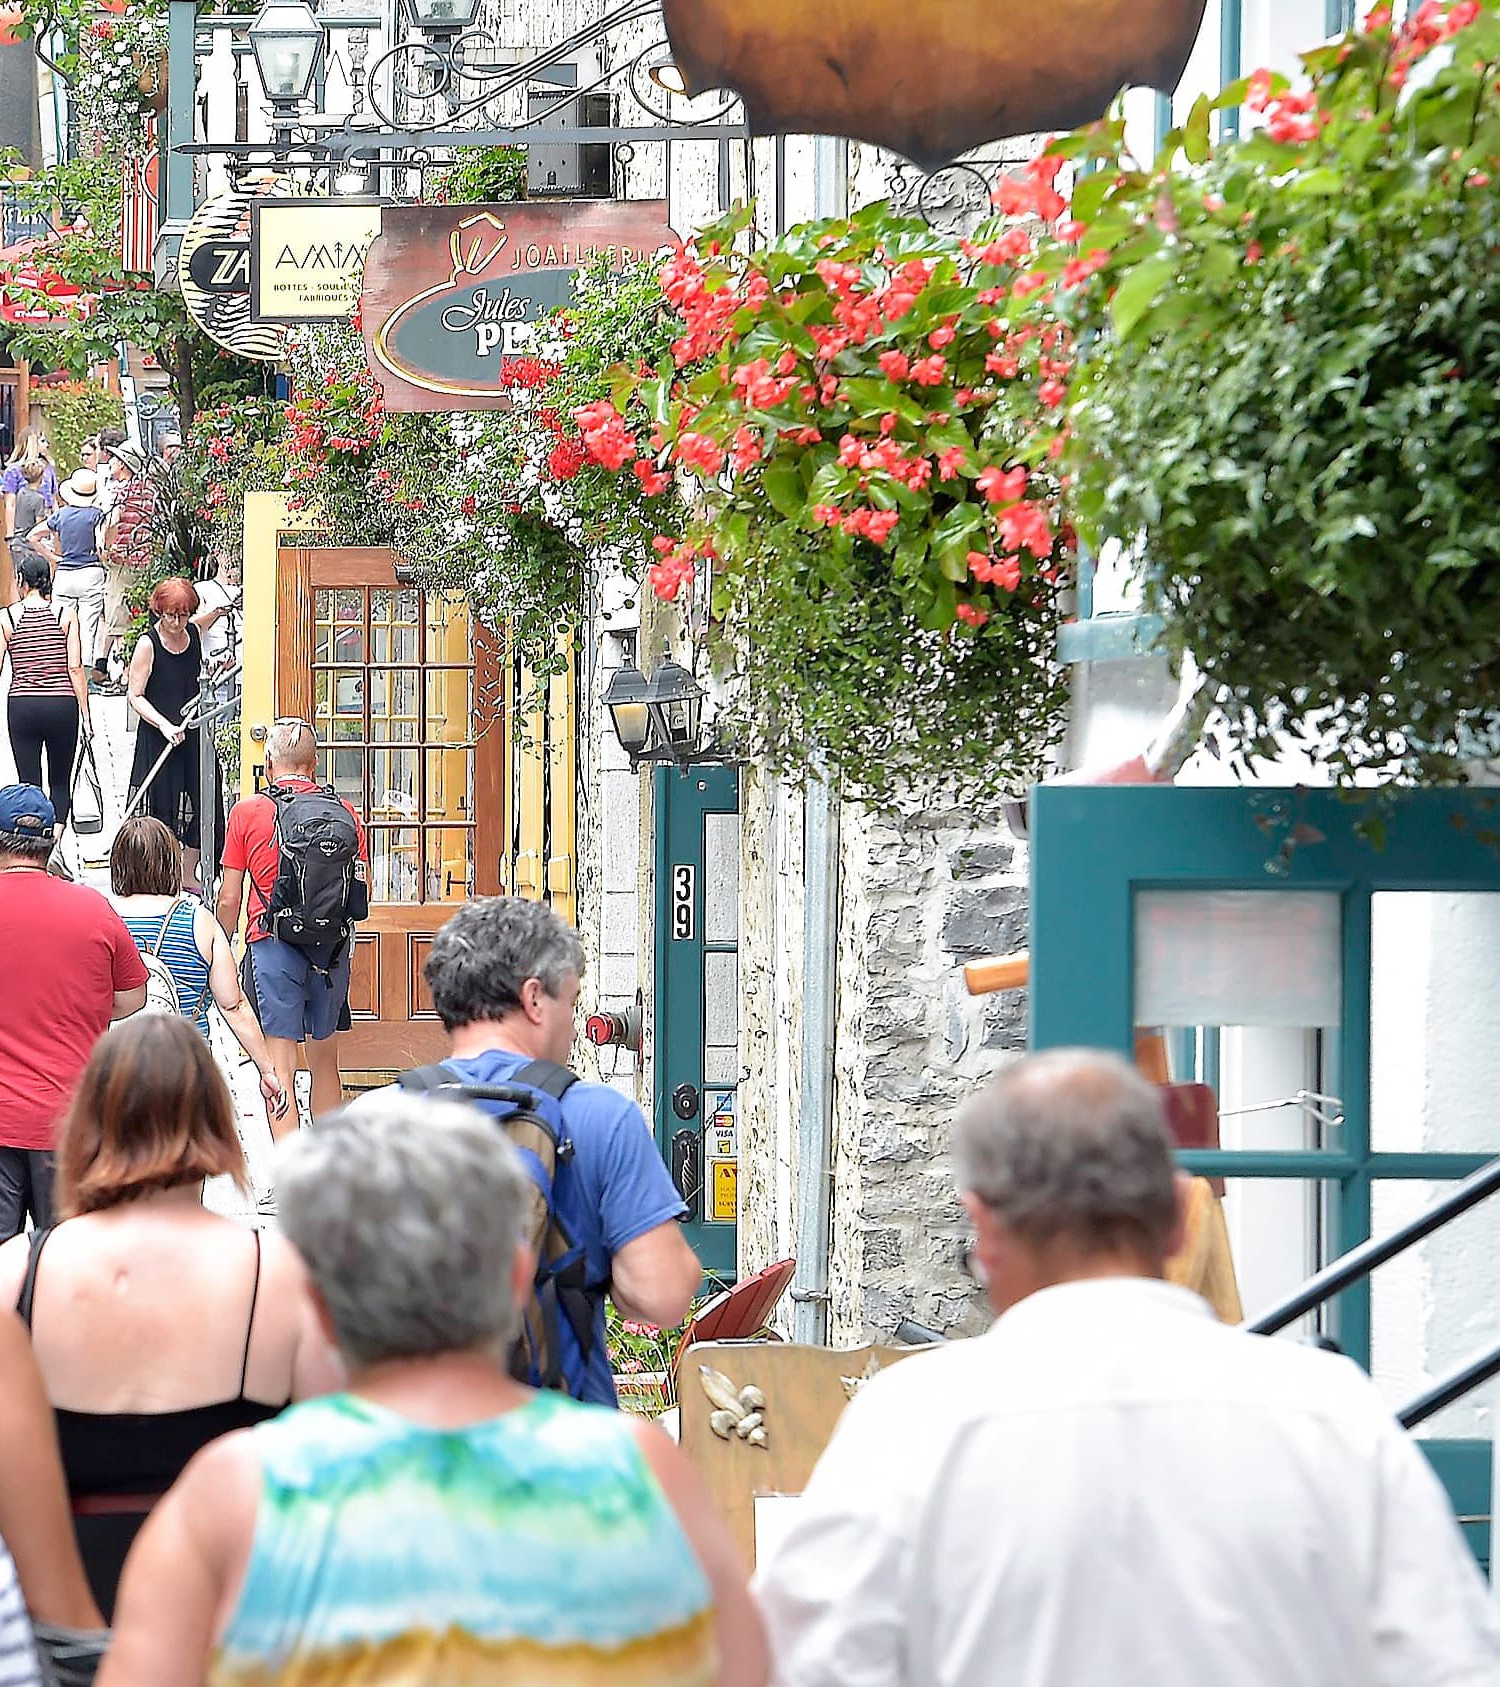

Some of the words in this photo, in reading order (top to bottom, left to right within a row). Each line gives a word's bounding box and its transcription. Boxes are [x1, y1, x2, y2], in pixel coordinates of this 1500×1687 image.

[273, 283, 308, 291] BOTTES
[441, 287, 532, 332] Jules
[675, 867, 691, 938] 39
[715, 1129, 734, 1137] VISA
